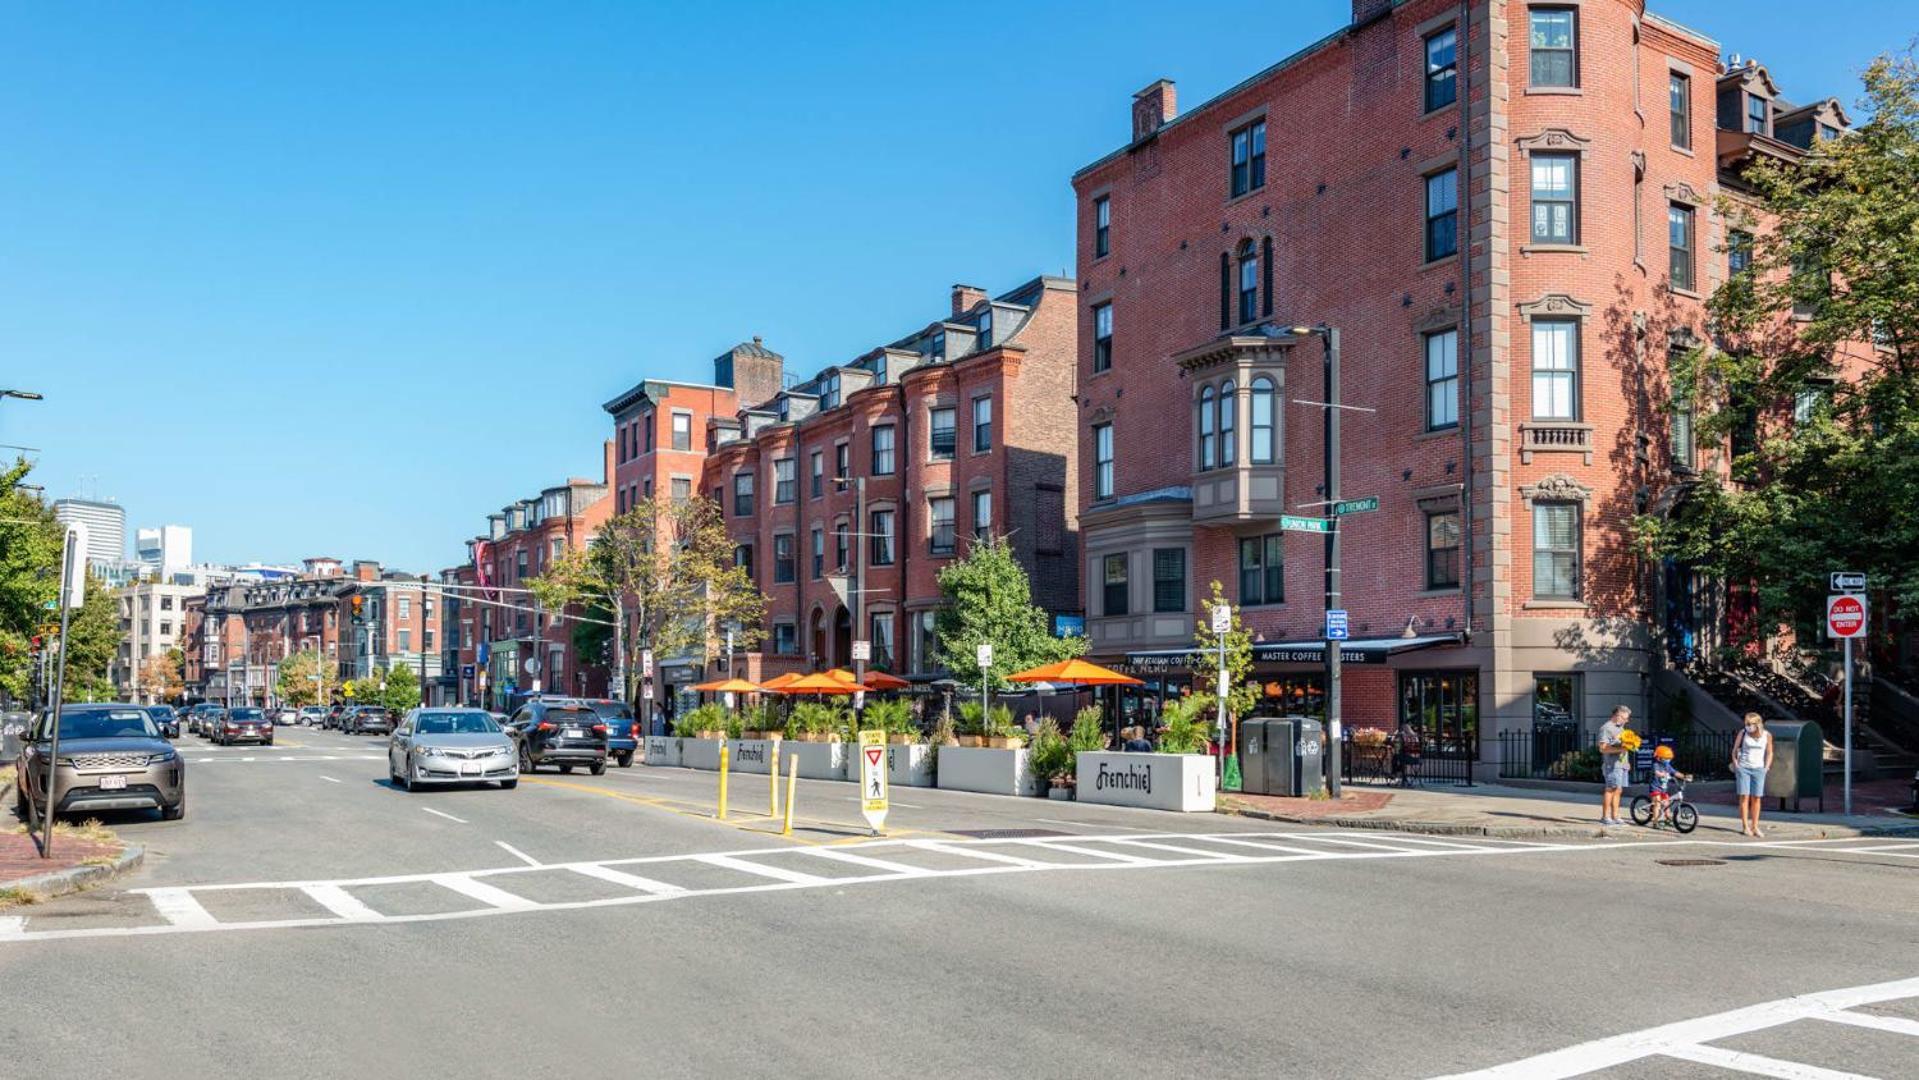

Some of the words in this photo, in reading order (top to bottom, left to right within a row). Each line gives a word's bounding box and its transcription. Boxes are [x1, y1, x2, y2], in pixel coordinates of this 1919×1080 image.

[1345, 500, 1371, 512] TREMONT
[1846, 604, 1860, 612] NOT
[1261, 652, 1289, 660] MASTER
[1291, 652, 1321, 661] COFFEE
